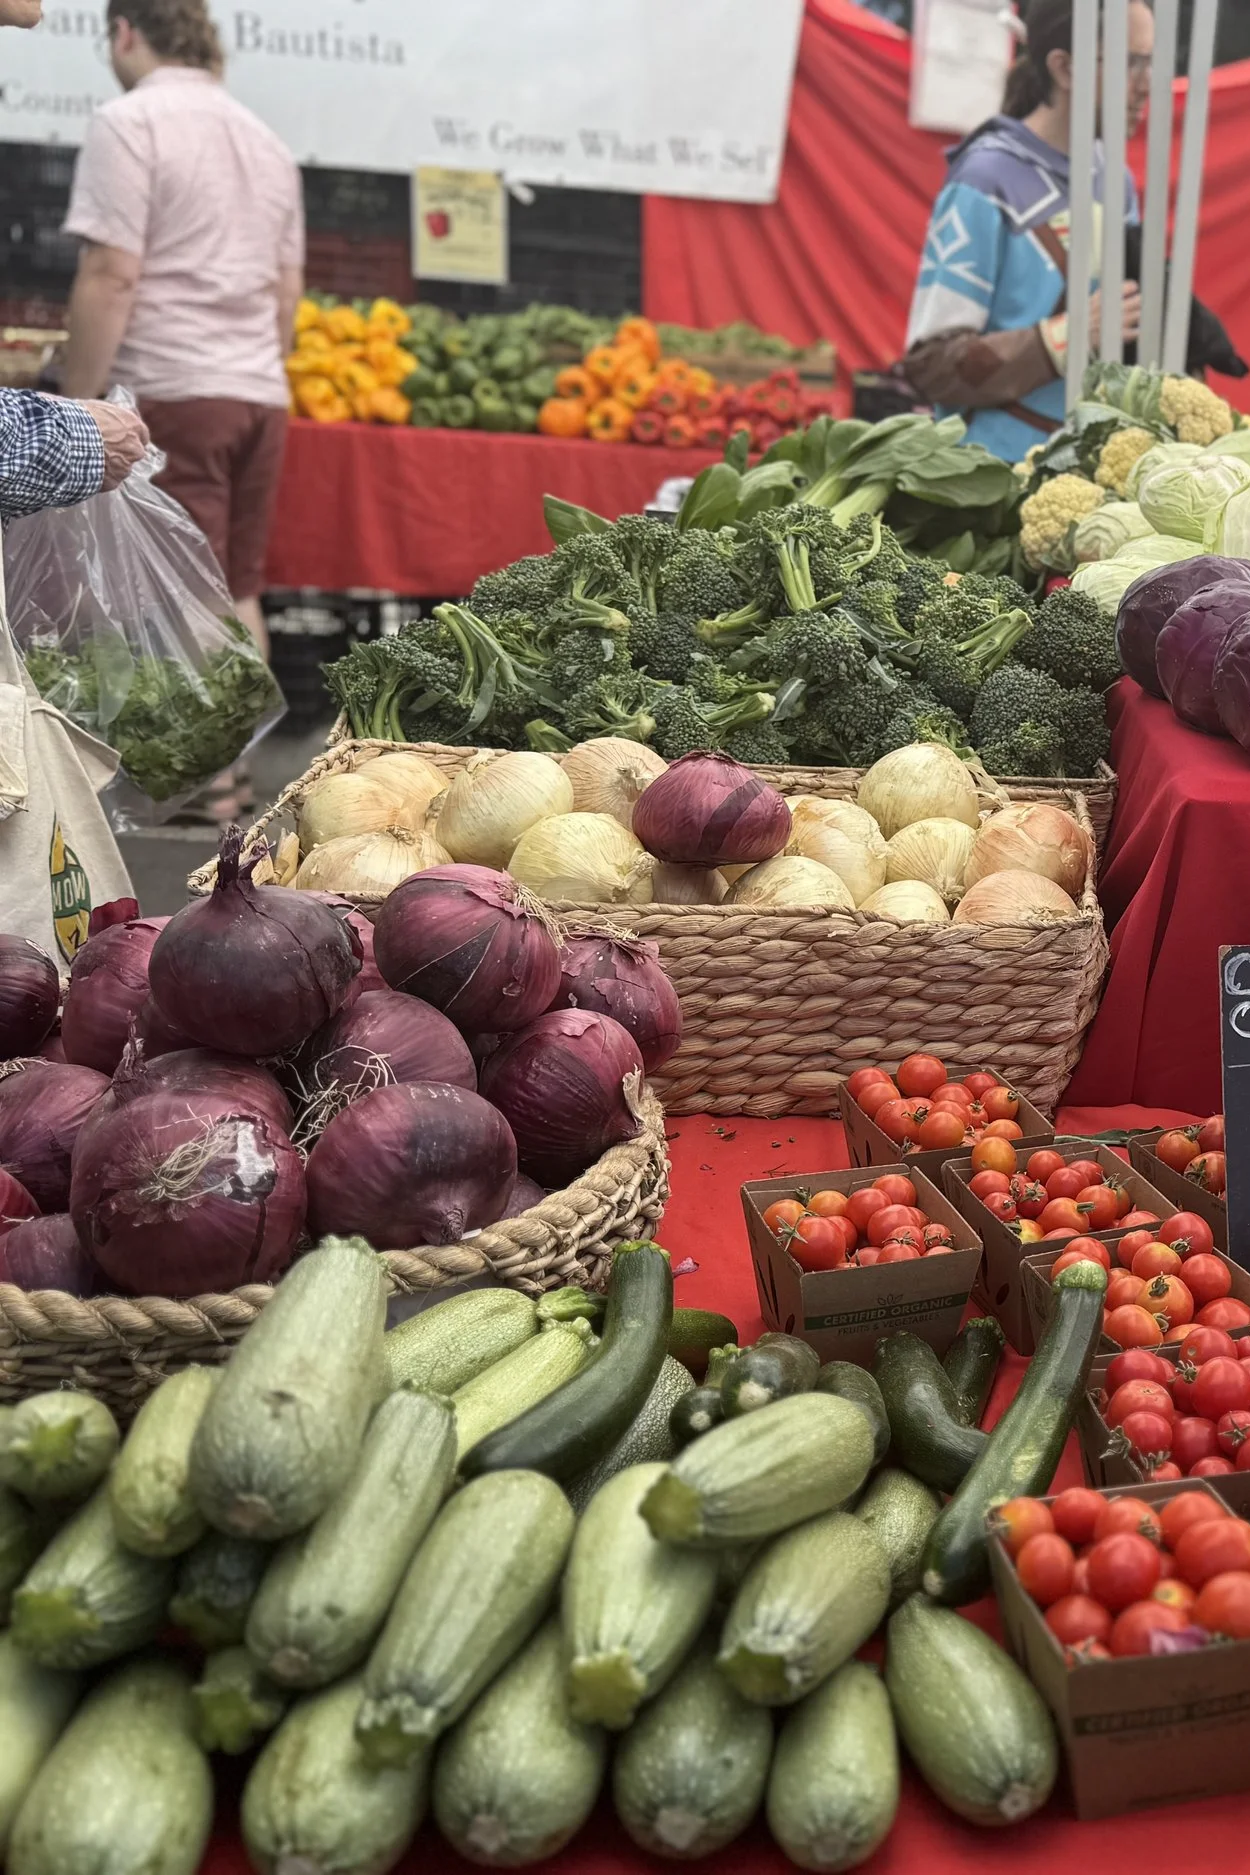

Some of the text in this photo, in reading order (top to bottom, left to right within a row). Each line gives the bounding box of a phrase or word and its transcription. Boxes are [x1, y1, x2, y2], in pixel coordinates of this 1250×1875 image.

[234, 10, 406, 65] Bautista
[432, 117, 481, 148] We
[488, 121, 567, 157] Grow
[578, 127, 658, 163] What
[668, 136, 712, 168] We
[823, 1296, 953, 1326] CERTIFIED ORGANIC
[837, 1323, 869, 1336] FRUITS
